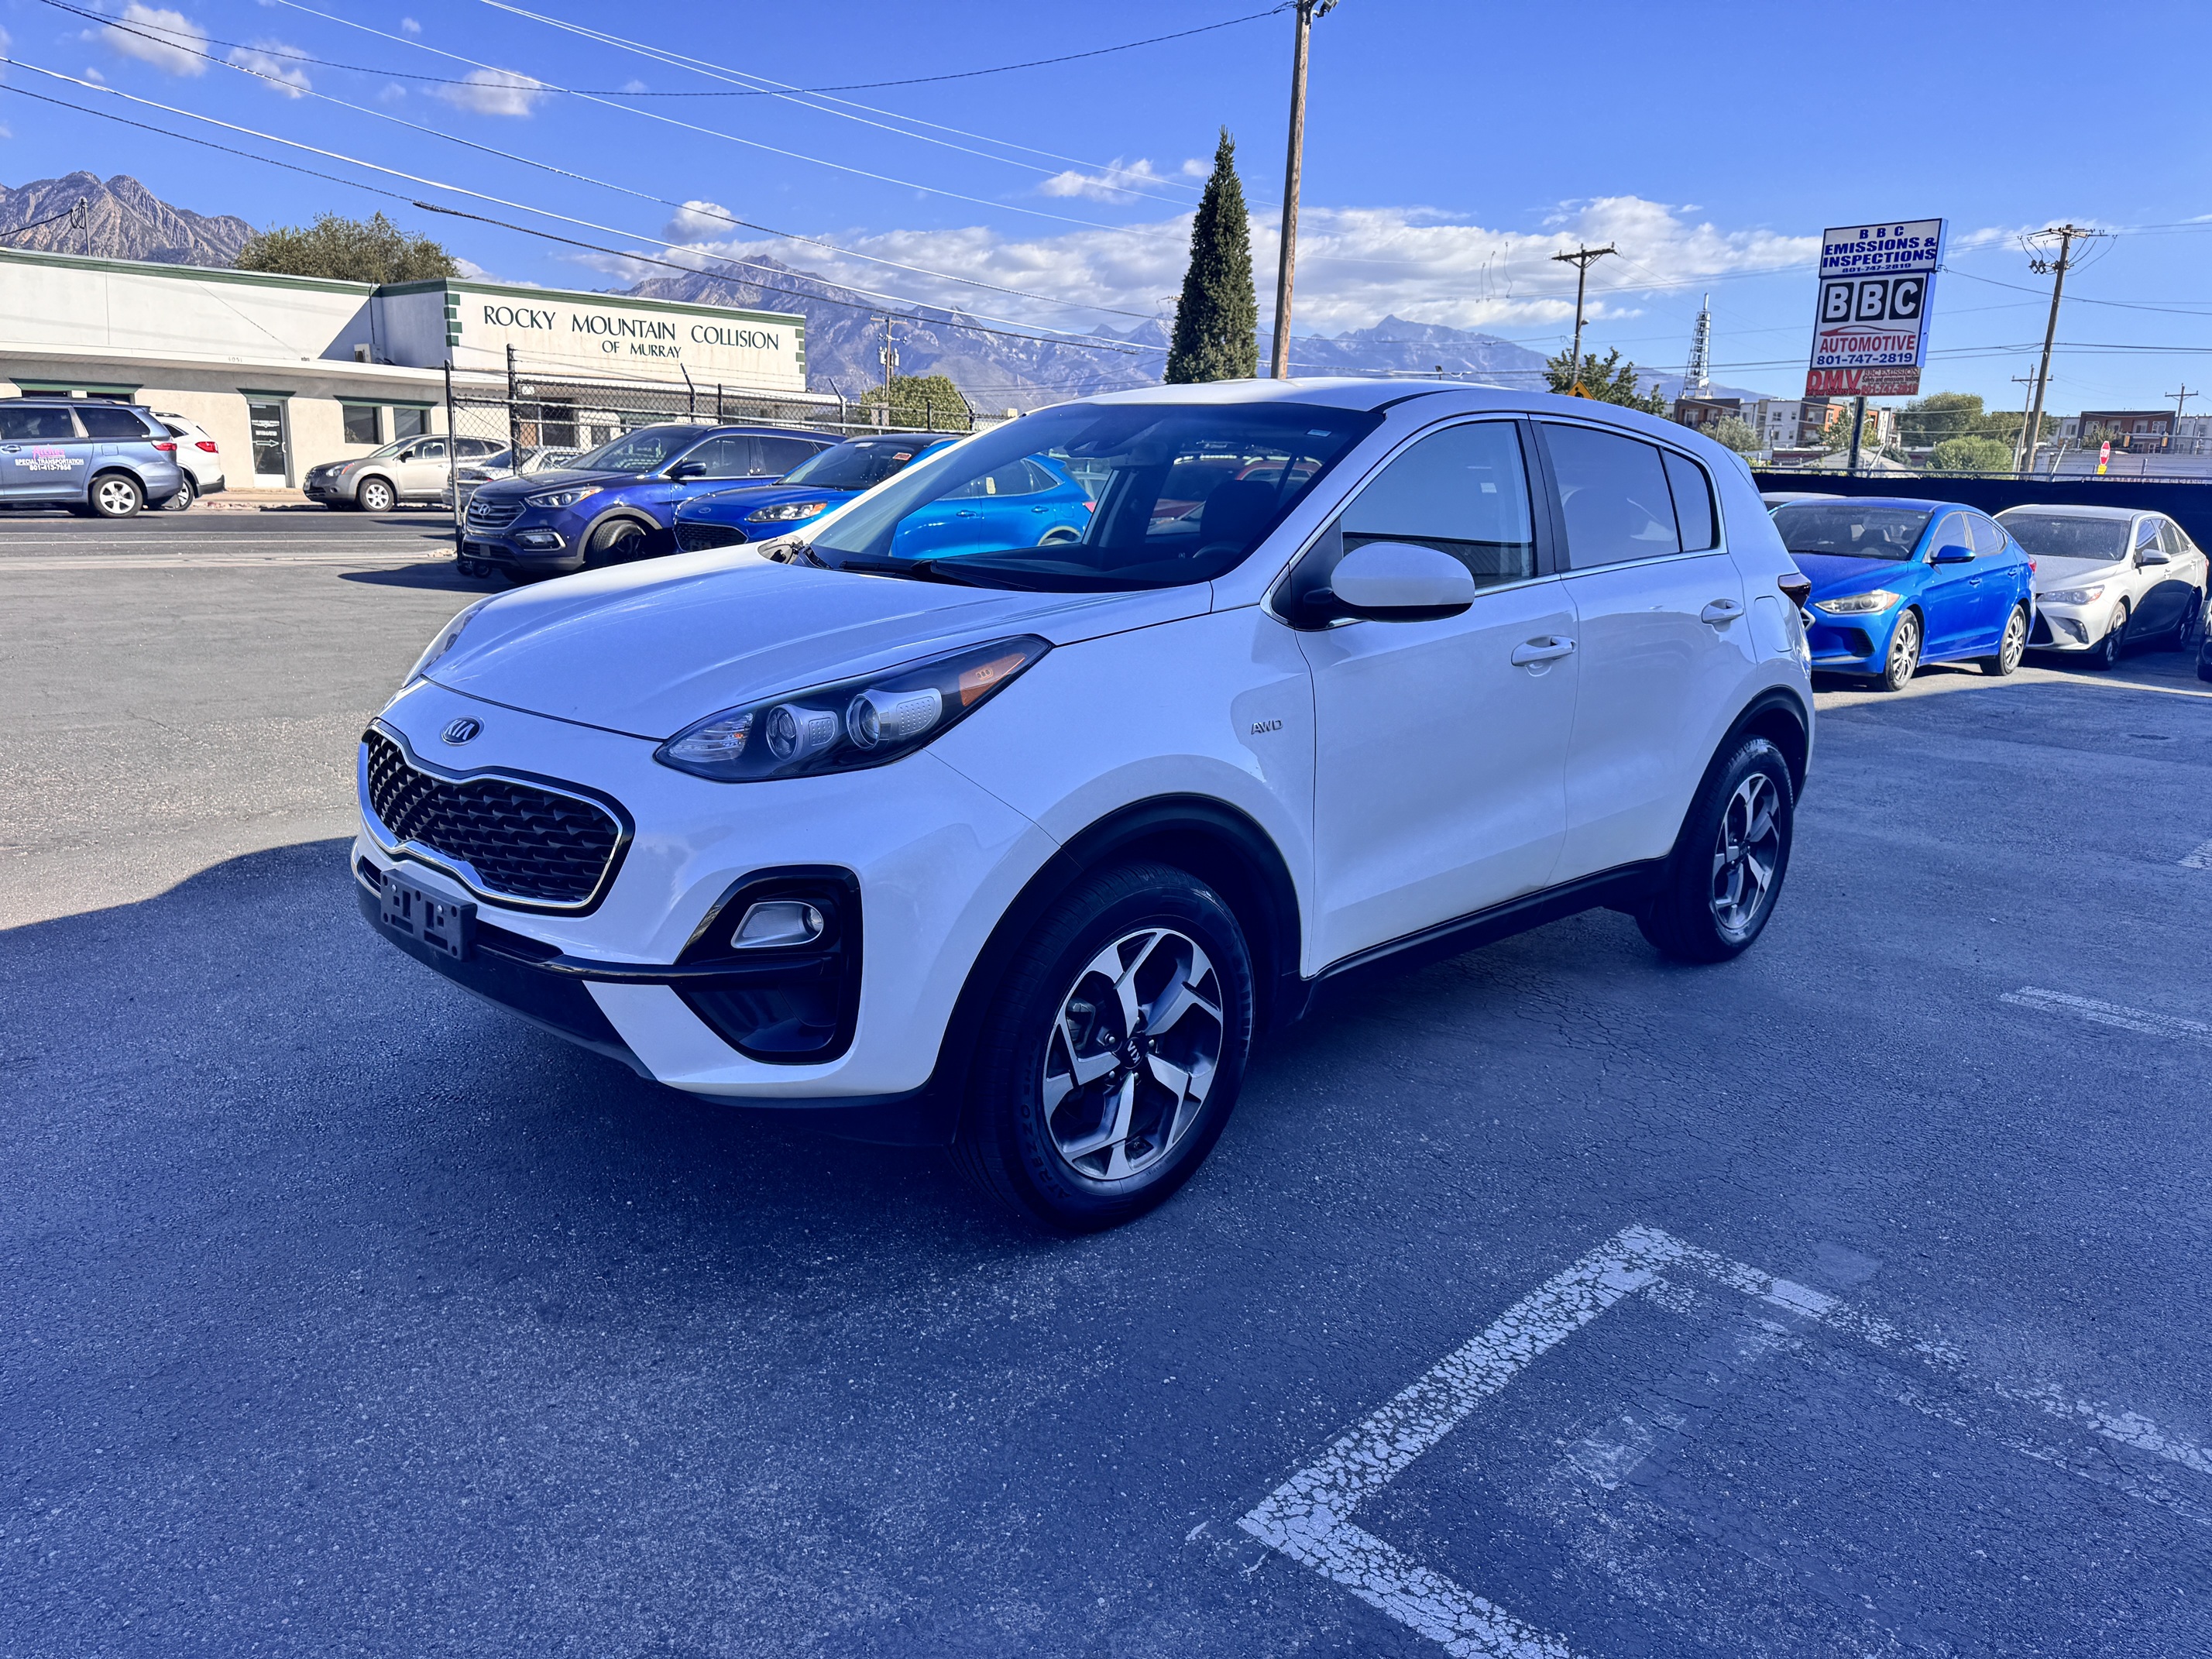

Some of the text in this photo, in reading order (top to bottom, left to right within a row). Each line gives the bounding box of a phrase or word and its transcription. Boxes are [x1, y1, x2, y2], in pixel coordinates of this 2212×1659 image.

[1824, 237, 1936, 256] EMISSIONS &
[1822, 249, 1936, 268] INSPECTIONS
[1842, 263, 1911, 273] 801-747-2819
[1824, 280, 1920, 320] BBC
[483, 305, 779, 350] ROCKY MOUNTAIN COLLISION
[602, 340, 682, 359] OF MURRAY
[1819, 335, 1916, 353] AUTOMOTIVE
[1817, 352, 1913, 365] 801-747-2819
[1806, 369, 1863, 390] DMV
[1881, 368, 1919, 376] EMISSION
[444, 719, 475, 740] KIA
[1251, 720, 1283, 735] AWD
[1127, 1040, 1141, 1064] KIA
